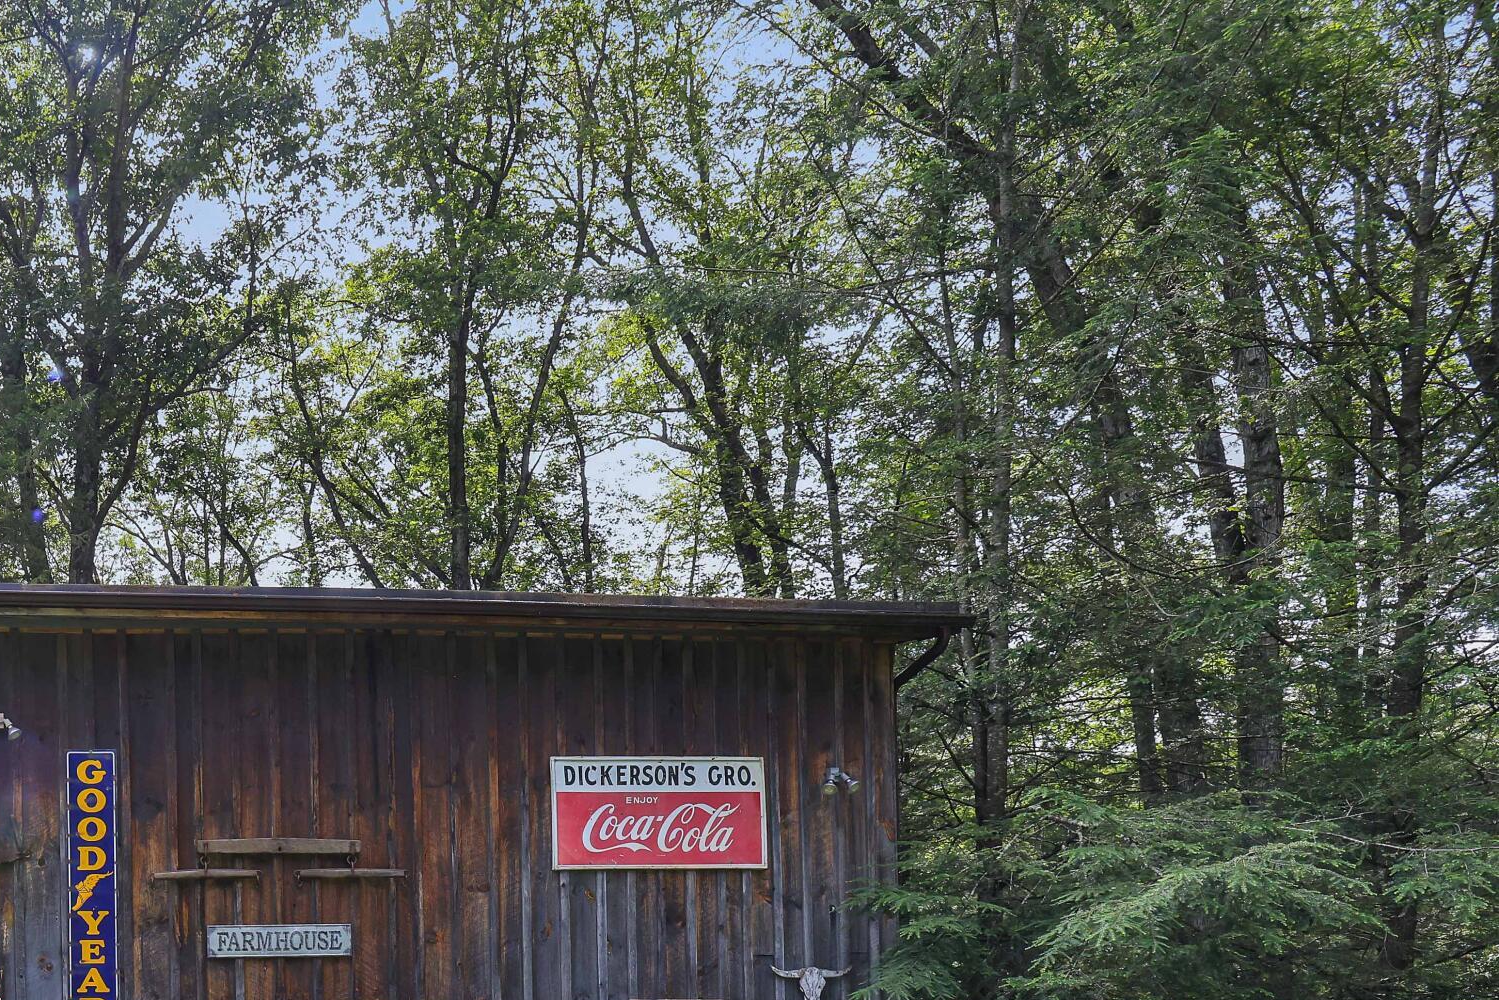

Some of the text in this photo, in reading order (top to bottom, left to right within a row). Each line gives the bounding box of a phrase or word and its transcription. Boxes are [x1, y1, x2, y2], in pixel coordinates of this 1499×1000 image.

[563, 762, 757, 787] DICKERSON'S GRO.
[625, 796, 659, 805] ENJOY
[582, 802, 741, 854] Coca-Cola
[216, 930, 343, 952] FARMHOUSE
